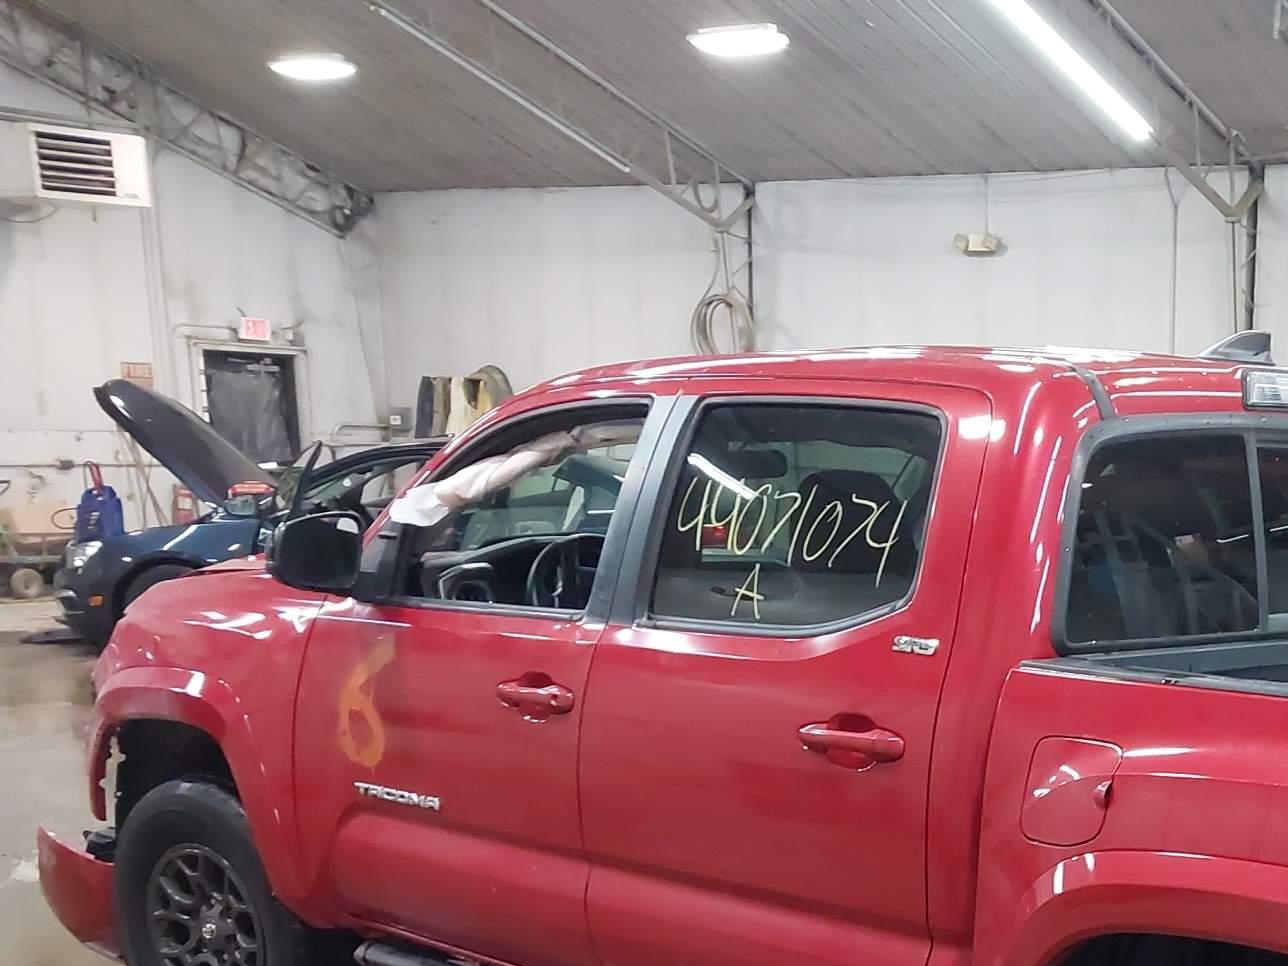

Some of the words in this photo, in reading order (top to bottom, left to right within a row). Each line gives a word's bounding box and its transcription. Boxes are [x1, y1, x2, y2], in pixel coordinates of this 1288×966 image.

[677, 476, 908, 589] 44071074
[731, 563, 764, 619] A
[339, 631, 396, 767] 6
[353, 781, 440, 811] TACOMA
